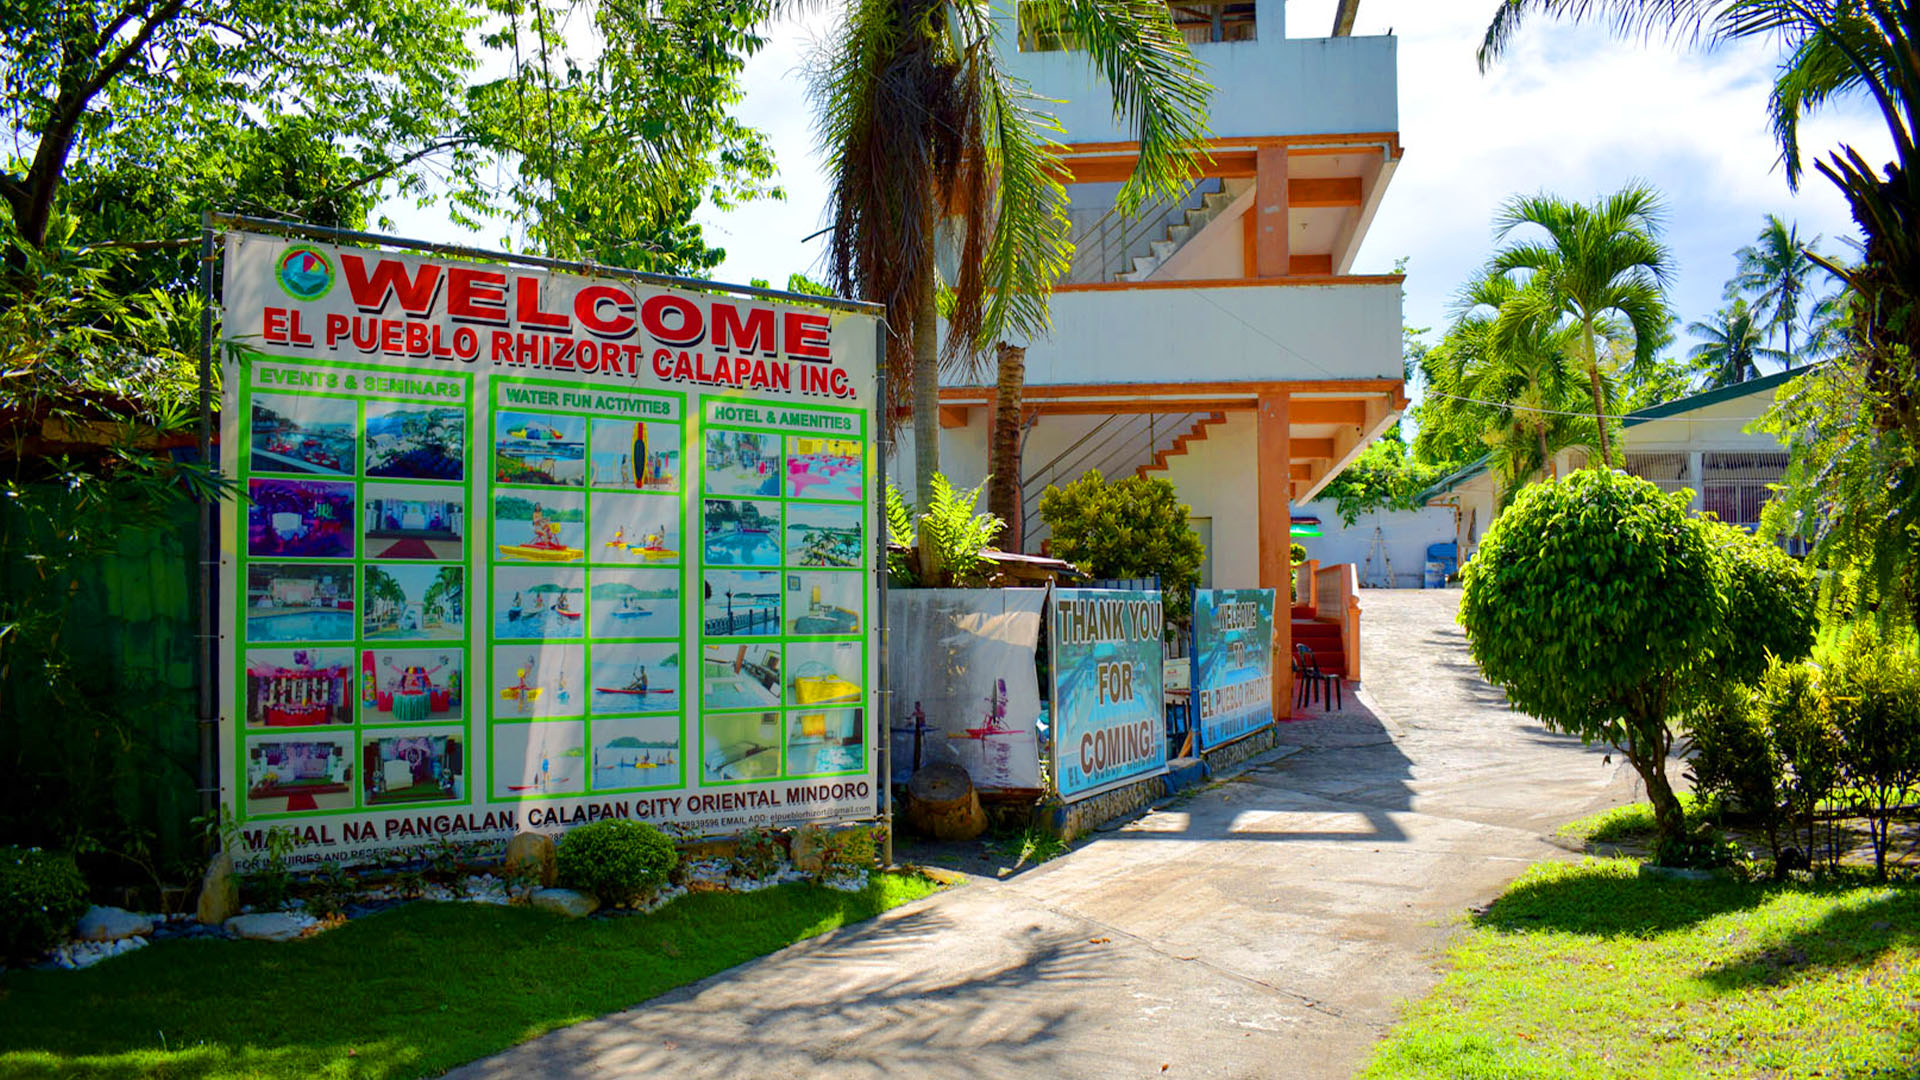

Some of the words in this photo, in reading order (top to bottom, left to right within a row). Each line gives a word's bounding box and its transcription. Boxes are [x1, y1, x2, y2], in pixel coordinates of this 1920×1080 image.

[340, 254, 833, 363] WELCOME
[263, 306, 314, 347] EL
[326, 313, 480, 363] PUEBLO
[491, 330, 643, 378] RHIZORT
[652, 348, 791, 393] CALAPAN
[800, 364, 857, 400] INC.
[260, 367, 339, 389] EVENTS
[344, 375, 358, 390] &
[363, 376, 461, 398] SEMINARS
[506, 388, 559, 407] WATER
[562, 393, 592, 409] FUN
[595, 396, 671, 416] ACTIVITIES
[715, 406, 763, 424] HOTEL
[766, 411, 776, 425] &
[779, 412, 851, 430] AMENITIES
[1058, 599, 1125, 643] THANK
[1128, 600, 1163, 640] YOU
[1218, 602, 1257, 632] WELCOME
[1233, 641, 1245, 668] TO
[1098, 661, 1133, 705] FOR
[1200, 690, 1213, 719] EL
[1080, 719, 1155, 775] COMING!
[342, 820, 378, 844] NA
[385, 810, 520, 840] PANGALAN,
[528, 801, 629, 828] CALAPAN
[635, 796, 681, 819] CITY
[687, 789, 781, 813] ORIENTAL
[786, 781, 869, 805] MINDORO
[264, 852, 321, 870] INUIRIES
[324, 849, 348, 864] AND
[722, 816, 747, 827] EMAIL
